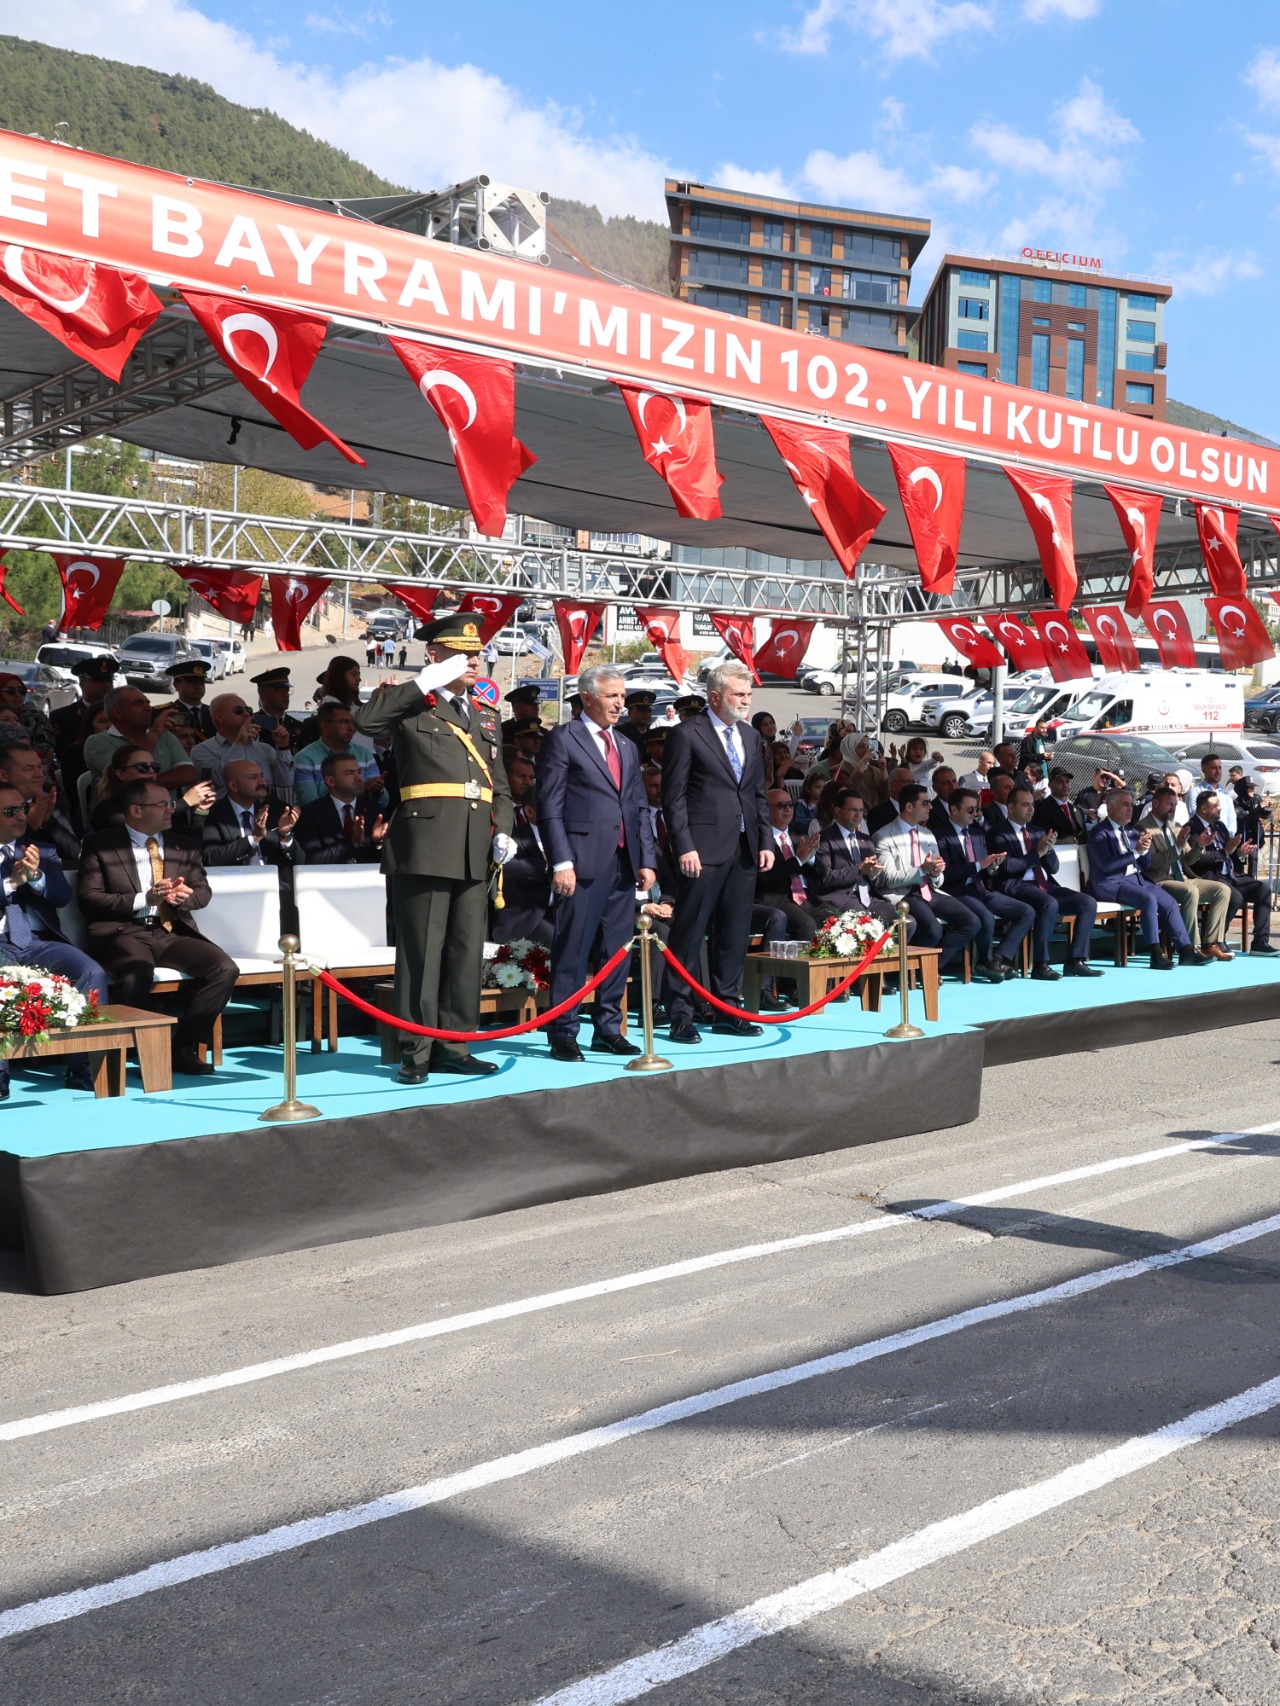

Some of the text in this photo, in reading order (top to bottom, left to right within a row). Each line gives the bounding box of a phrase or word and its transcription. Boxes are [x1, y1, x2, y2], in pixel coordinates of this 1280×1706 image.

[1022, 247, 1102, 269] OFFICIUM
[152, 193, 762, 386] BAYRAMI'MIZIN
[780, 349, 887, 413] 102.
[902, 375, 992, 435] YILI
[1007, 401, 1139, 465] KUTLU
[1150, 436, 1268, 494] OLSUN
[1202, 710, 1220, 721] 112
